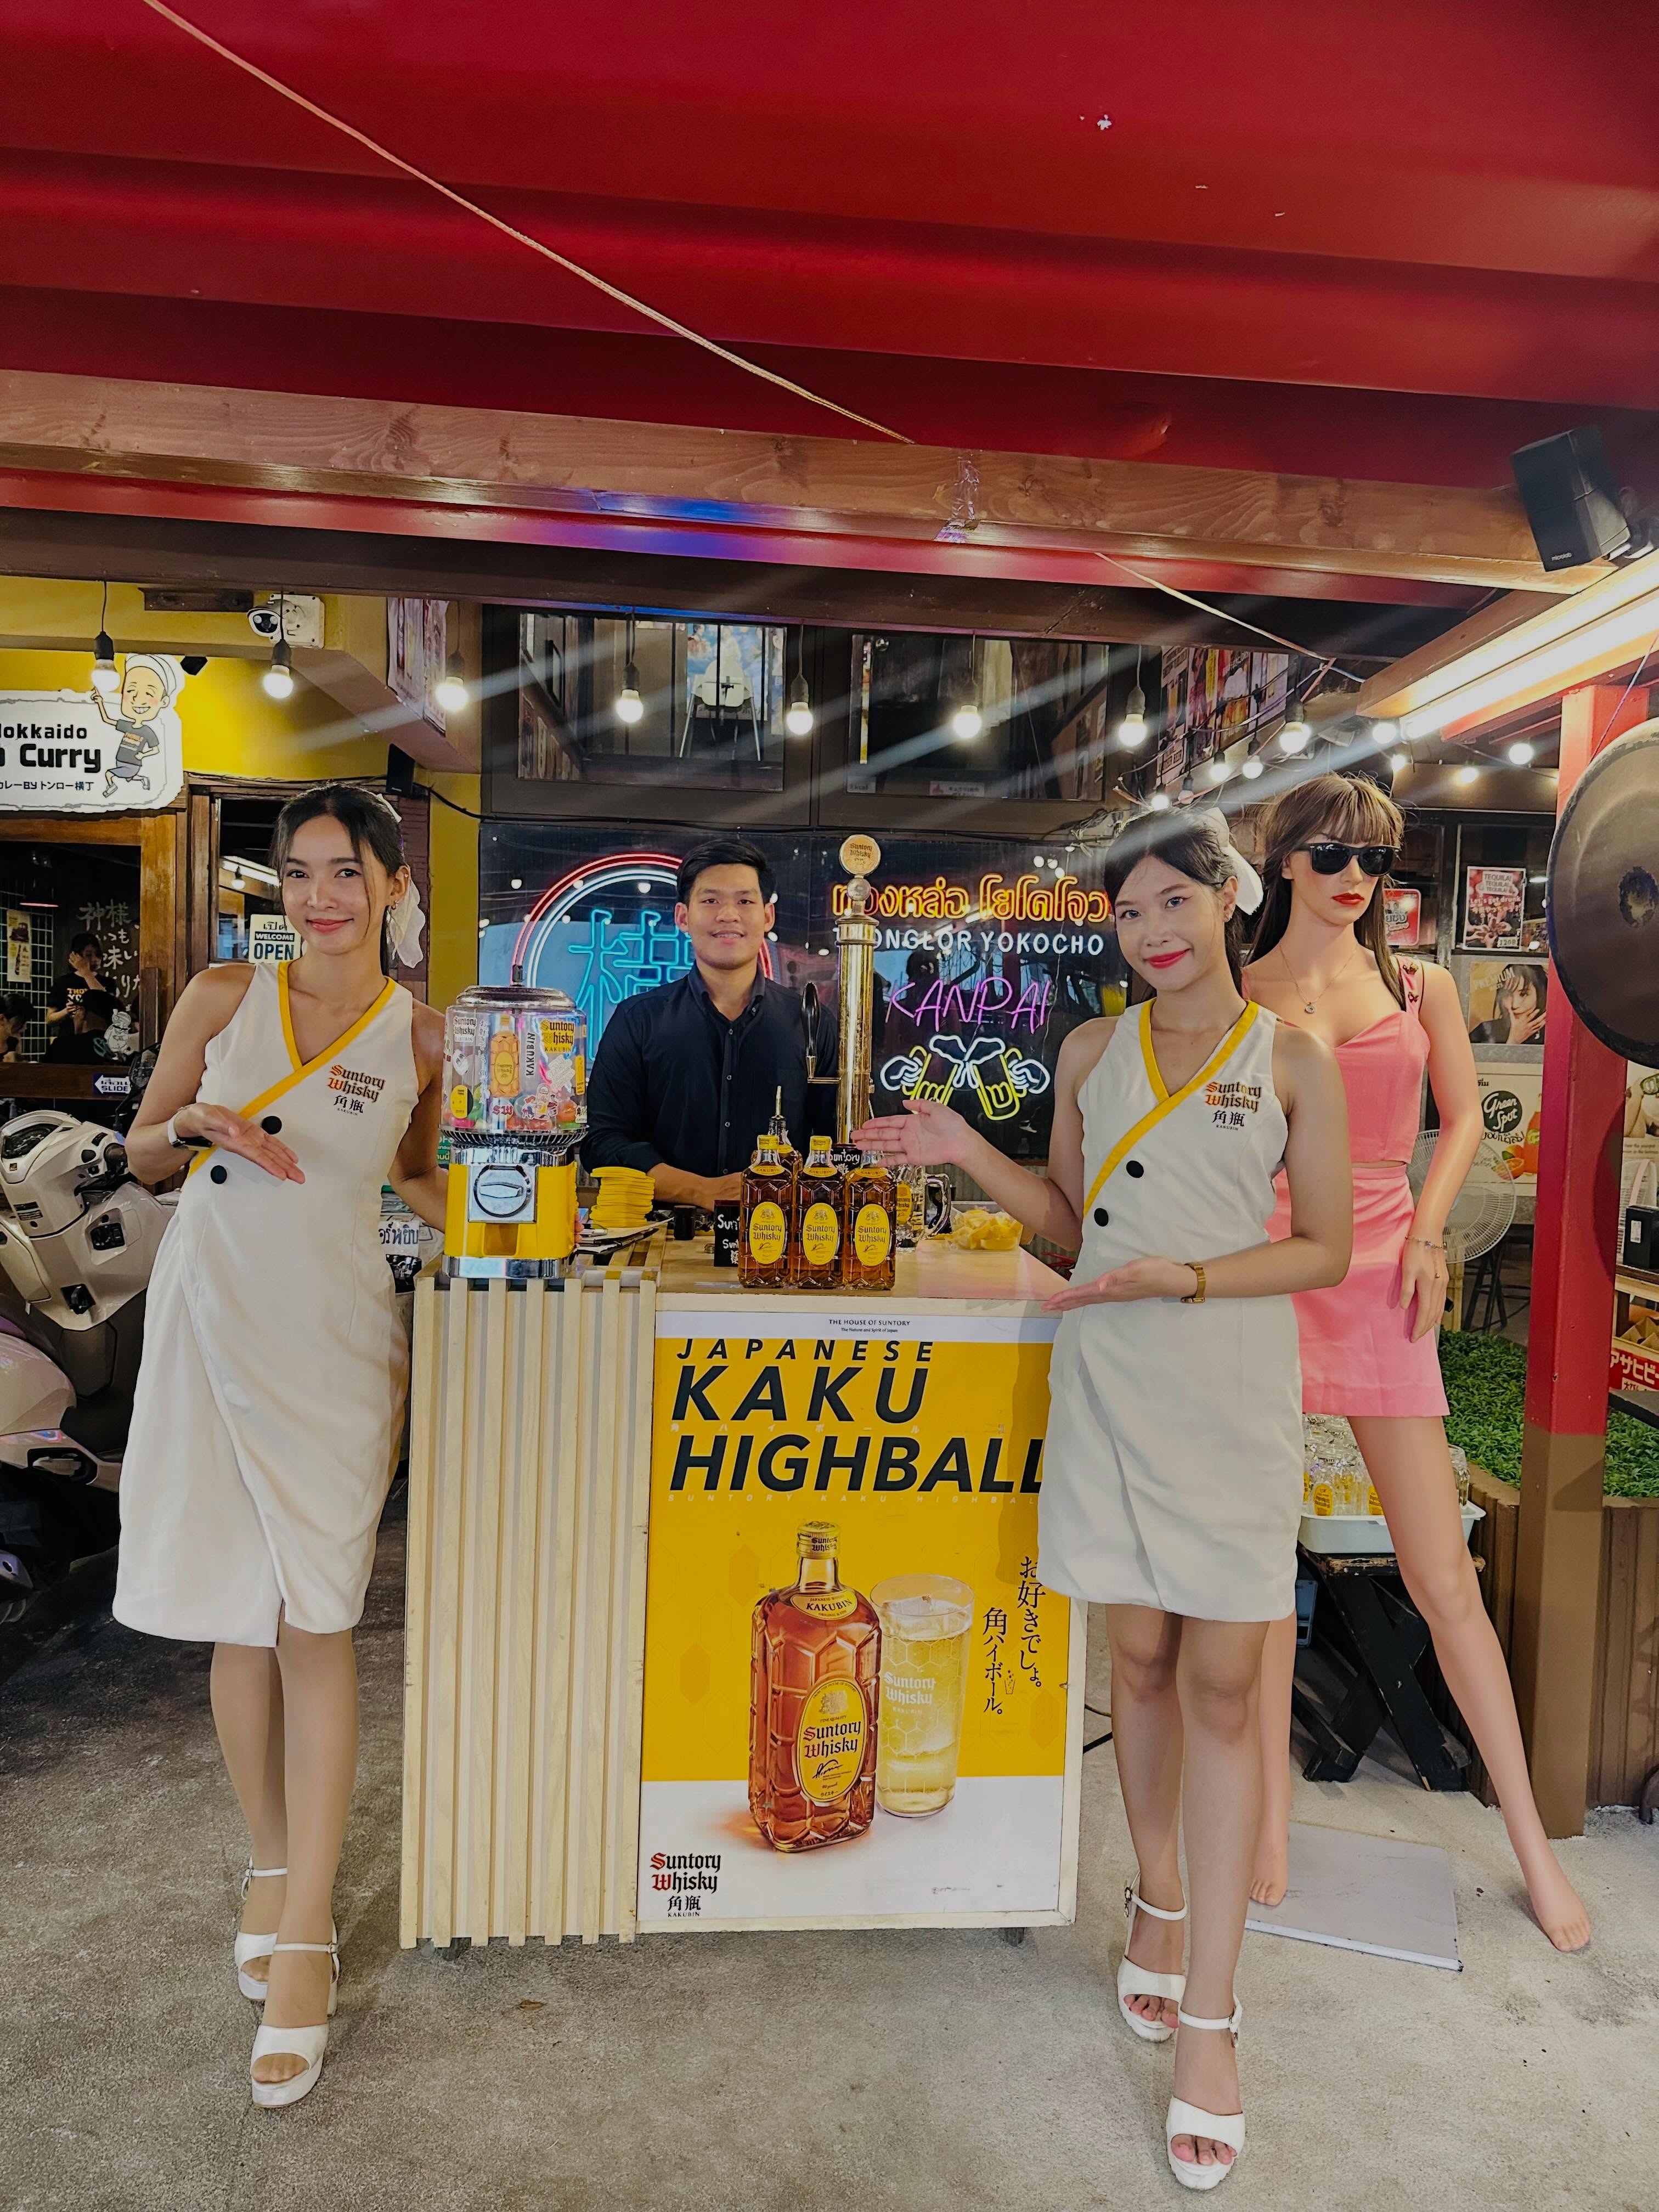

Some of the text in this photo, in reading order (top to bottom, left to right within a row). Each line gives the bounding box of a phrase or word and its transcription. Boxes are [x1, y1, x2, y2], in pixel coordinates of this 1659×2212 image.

[0, 724, 87, 739] okkaido
[20, 743, 101, 773] Curry
[254, 943, 295, 961] OPEN
[980, 931, 1104, 956] YOKOCHO
[885, 977, 1050, 1034] KANPAI
[454, 1017, 476, 1028] Suntory
[454, 1026, 475, 1036] Whisky
[540, 1019, 574, 1034] Suntory
[541, 1032, 573, 1046] Whisky
[526, 1032, 535, 1076] KAKUBIN
[330, 1065, 386, 1090] Suntory
[328, 1078, 379, 1103] Whisky
[1205, 1081, 1262, 1099] Suntory
[1205, 1093, 1259, 1114] Whisky
[1483, 1093, 1517, 1119] Green
[1493, 1108, 1518, 1132] Spot
[753, 1223, 782, 1233] Suntory
[753, 1232, 781, 1241] Whisky
[806, 1224, 835, 1234] Suntory
[806, 1233, 834, 1243] Whisky
[857, 1225, 887, 1234] Suntory
[859, 1234, 885, 1244] Whisky
[676, 1339, 933, 1362] JAPANESE
[672, 1365, 929, 1424] KAKU
[670, 1434, 1043, 1493] HIGHBALL
[806, 1599, 853, 1611] KAKUBIN
[1017, 1556, 1046, 1688] お好きでしょ。
[983, 1607, 1007, 1715] 角ハイボール。
[884, 1671, 936, 1691] Suntory
[885, 1686, 933, 1706] Whisky
[803, 1721, 861, 1742] Suntory
[804, 1737, 858, 1758] Whisky
[650, 1853, 721, 1873] Suntory
[651, 1871, 718, 1894] Whisky
[667, 1895, 701, 1912] 角瓶
